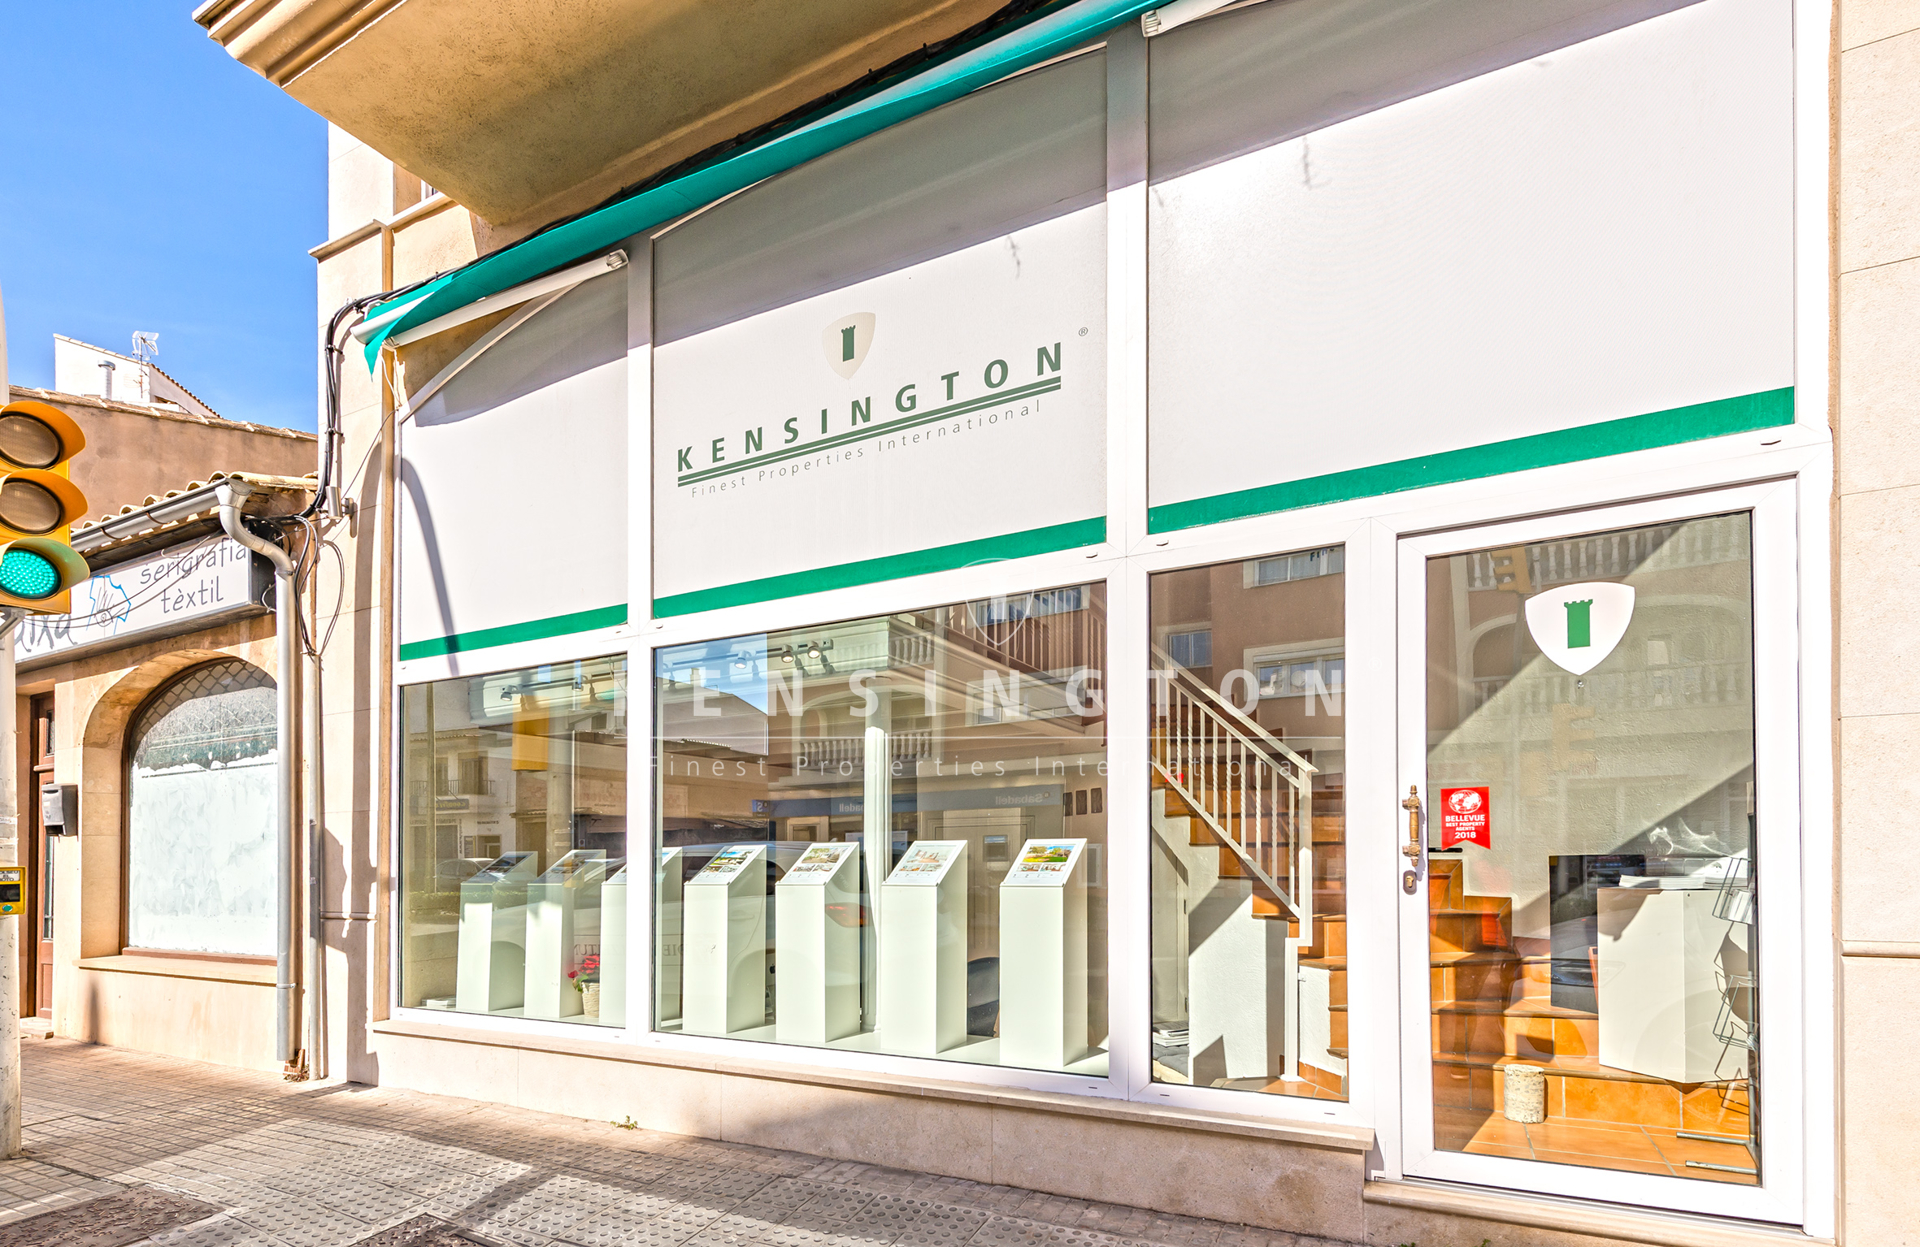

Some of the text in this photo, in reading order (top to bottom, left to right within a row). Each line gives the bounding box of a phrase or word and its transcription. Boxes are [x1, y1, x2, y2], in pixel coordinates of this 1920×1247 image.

[677, 342, 1061, 472] KENSINGTON
[691, 399, 1041, 498] Finest Properties International
[161, 575, 224, 614] tèxtil
[1445, 814, 1485, 822] BELLEVUE
